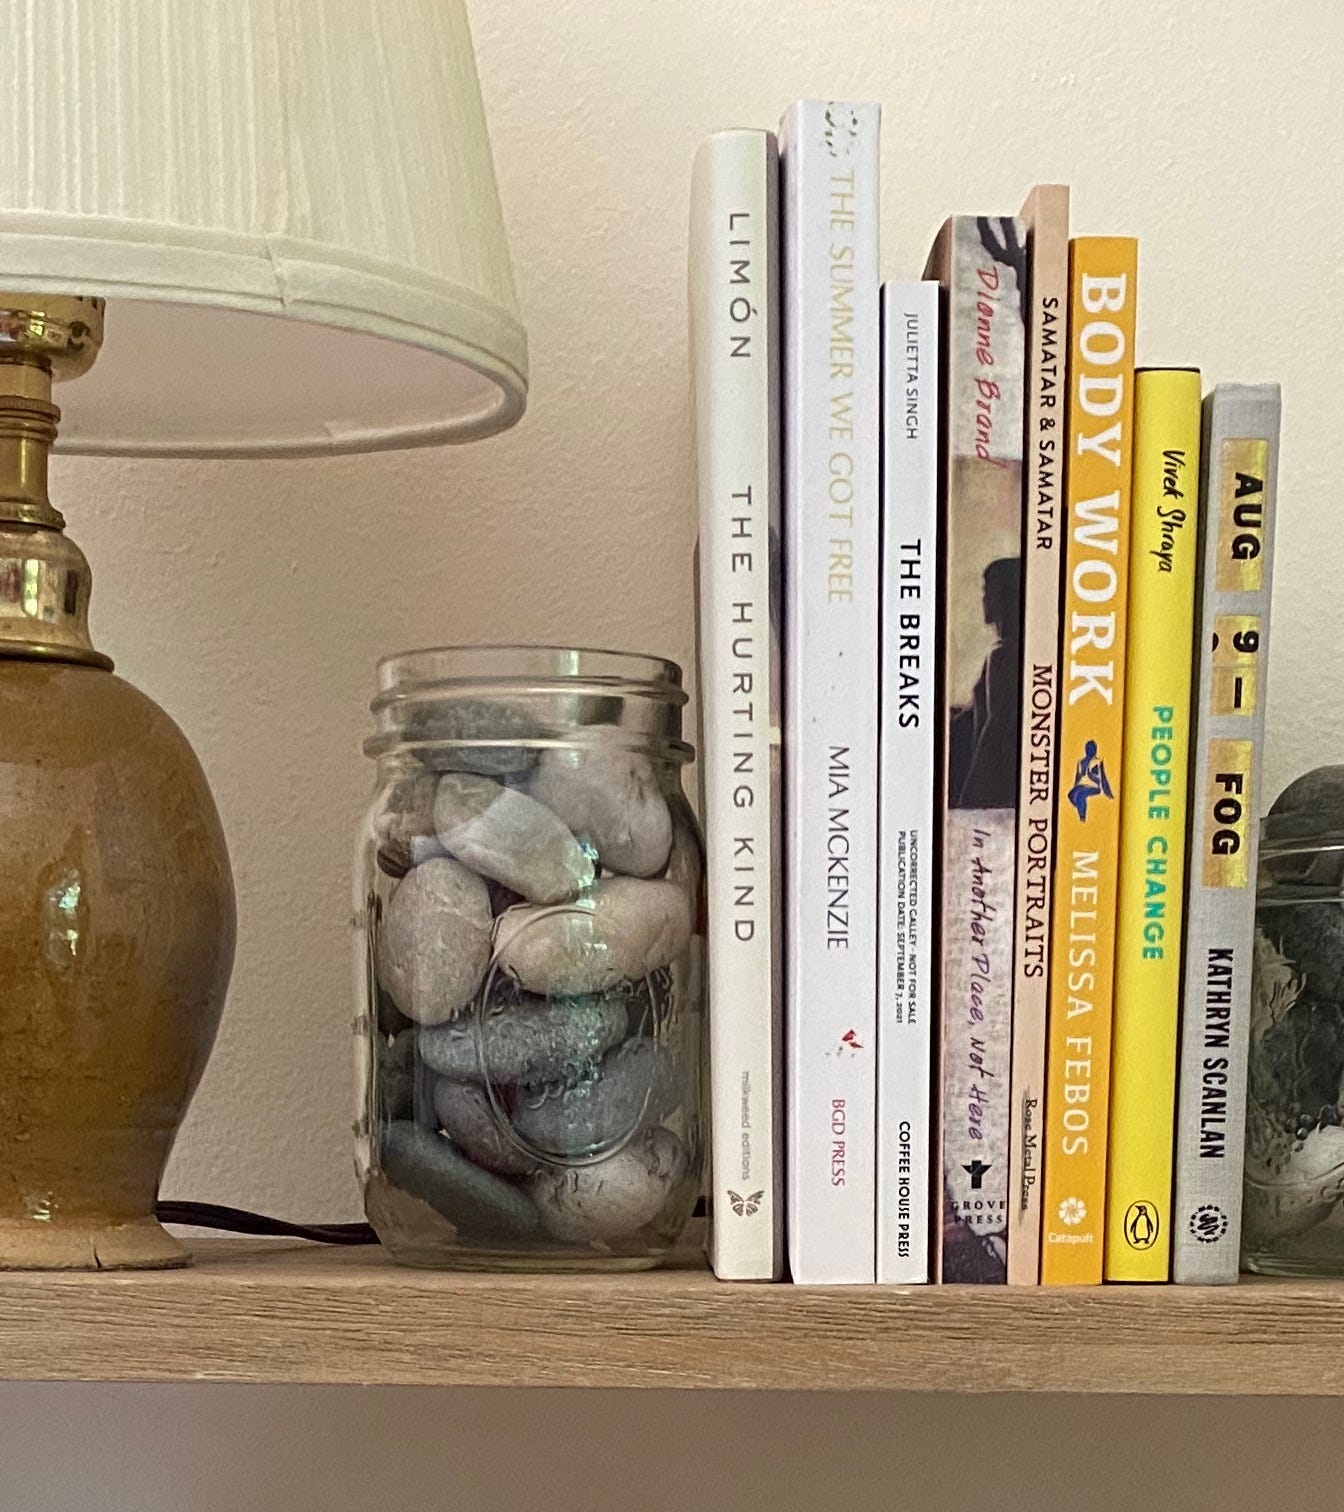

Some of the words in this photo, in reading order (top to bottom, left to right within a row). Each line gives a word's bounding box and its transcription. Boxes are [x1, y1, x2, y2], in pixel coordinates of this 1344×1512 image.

[830, 170, 854, 233] THE
[729, 212, 758, 358] LIMÓN
[830, 246, 854, 380] SUMMER
[903, 312, 918, 385] JULIETTA
[1040, 297, 1058, 408] SAMATAR
[1077, 273, 1127, 467] BODY
[829, 392, 854, 440] WE
[906, 391, 919, 440] SINGH
[974, 377, 1010, 468] Brand
[1039, 418, 1056, 431] &
[829, 451, 854, 527] GOT
[1036, 440, 1055, 550] SAMATAR
[1162, 450, 1186, 499] Vivek
[1231, 471, 1263, 560] AUG
[731, 486, 752, 572] THE
[829, 539, 853, 603] FREE
[900, 539, 921, 598] THE
[1149, 506, 1186, 573] Shraya
[1068, 491, 1119, 705] WORK
[732, 603, 754, 807] HURTING
[899, 615, 920, 728] BREAKS
[828, 746, 849, 798] MIA
[1030, 665, 1052, 804] MONSTER
[1148, 706, 1174, 820] PEOPLE
[1211, 773, 1246, 856] FOG
[733, 838, 756, 942] KIND
[826, 809, 849, 950] MCKENZIE
[1024, 818, 1048, 979] PORTRAITS
[1142, 836, 1168, 960] CHANGE
[1066, 851, 1099, 1020] MELISSA
[1203, 948, 1234, 1048] KATHRYN
[966, 1084, 989, 1141] Here
[1062, 1037, 1092, 1155] FEBOS
[1199, 1058, 1229, 1158] SCANLAN
[898, 1121, 911, 1173] COFFEE
[898, 1178, 910, 1220] HOUSE
[898, 1224, 909, 1258] PRESS
